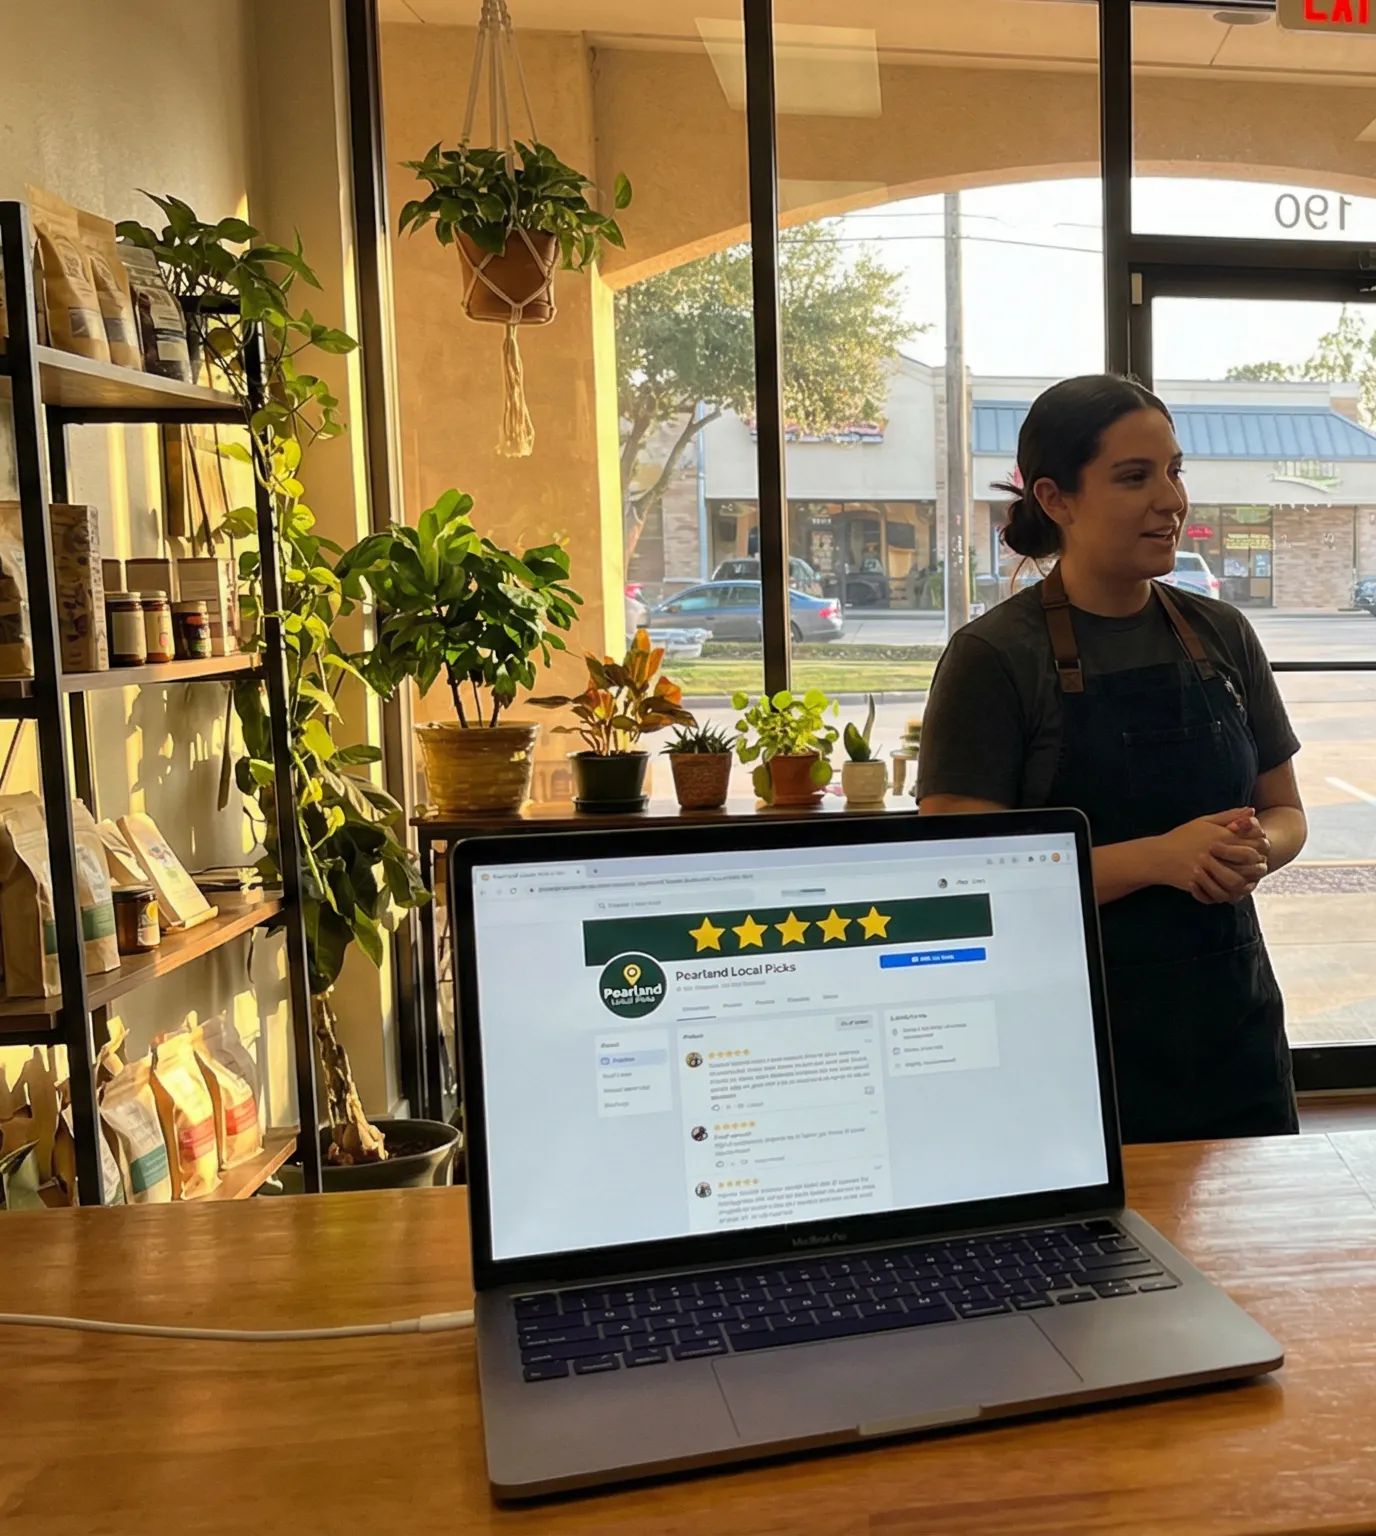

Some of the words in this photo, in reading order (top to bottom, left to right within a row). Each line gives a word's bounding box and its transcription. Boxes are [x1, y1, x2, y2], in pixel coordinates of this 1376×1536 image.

[731, 964, 763, 977] Local
[765, 963, 797, 974] Picks
[603, 983, 663, 1000] Pearland
